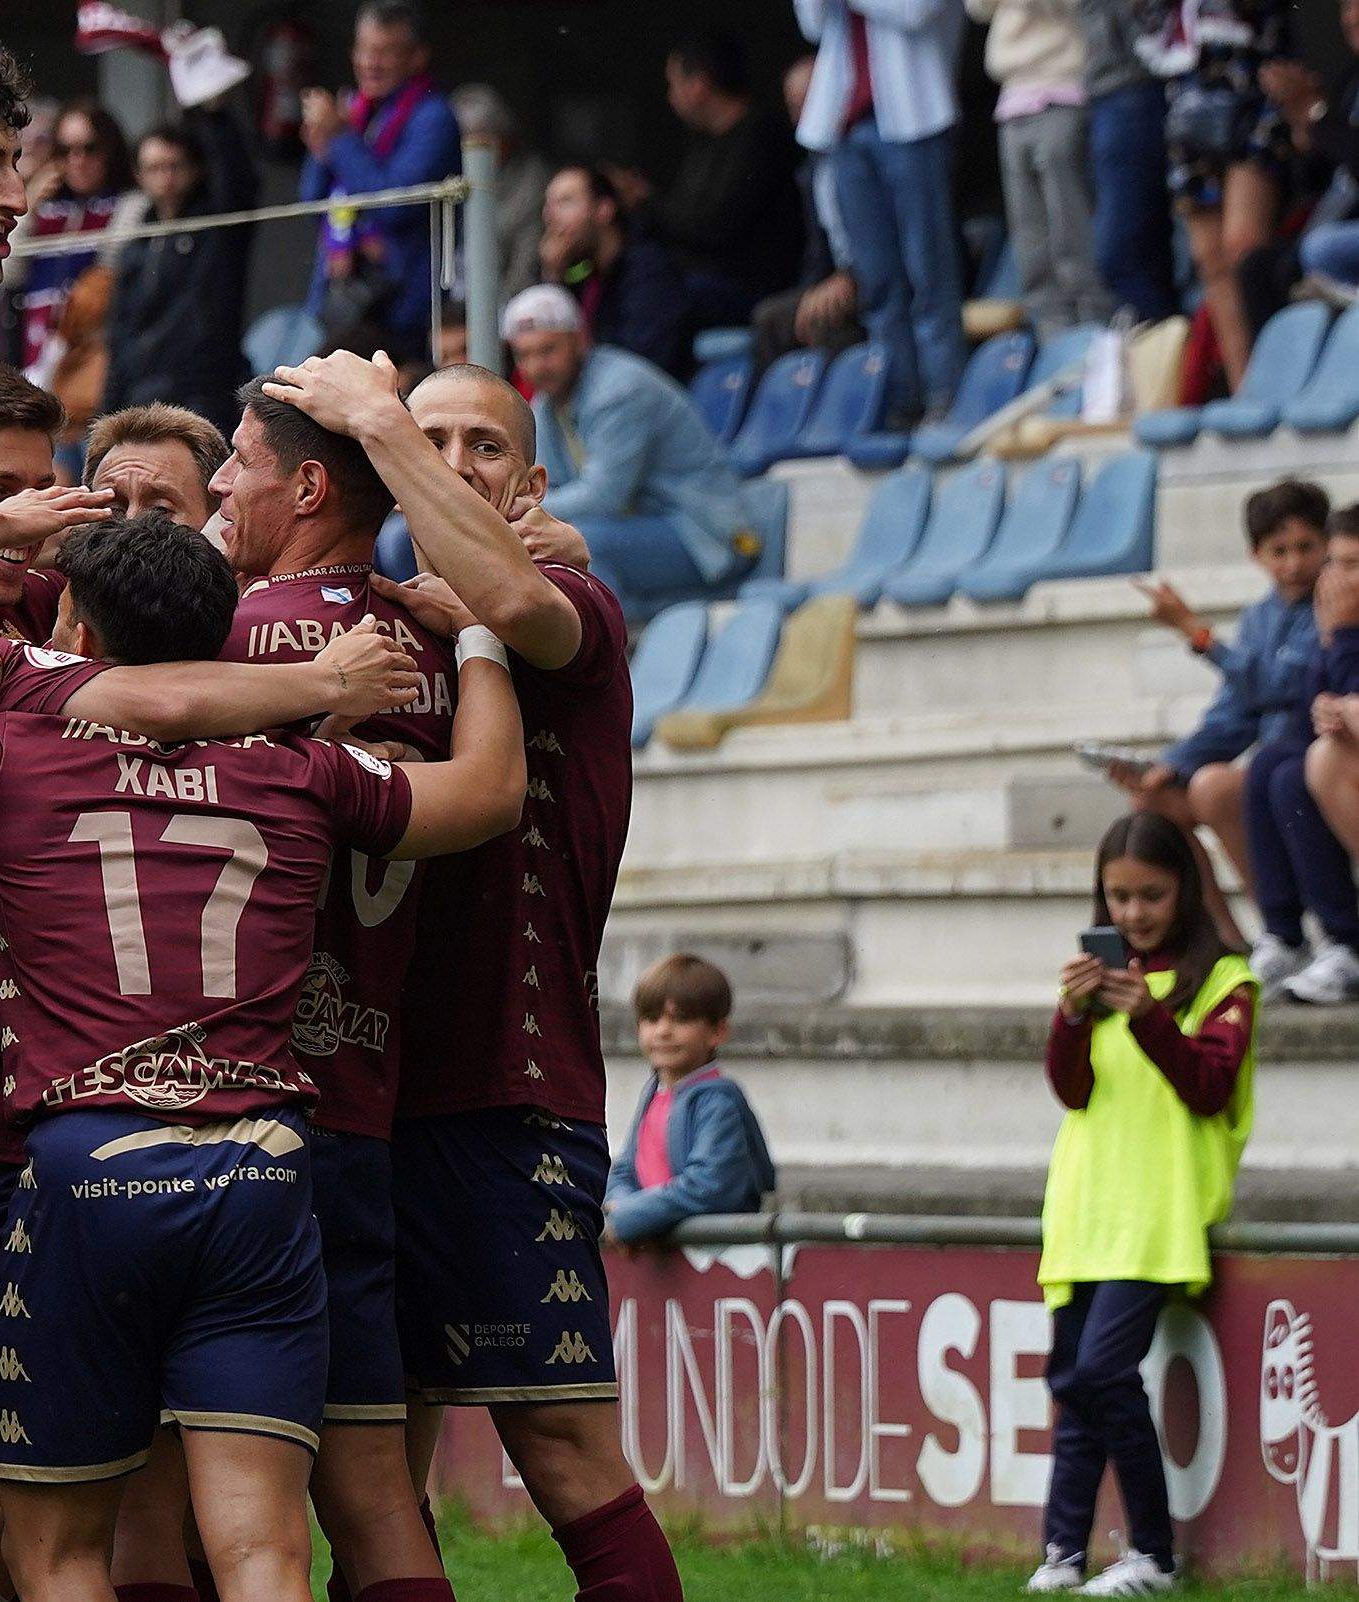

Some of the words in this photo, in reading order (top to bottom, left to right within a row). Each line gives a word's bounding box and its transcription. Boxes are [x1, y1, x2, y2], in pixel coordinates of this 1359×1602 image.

[271, 573, 295, 583] NON
[296, 566, 328, 579] PARAR
[328, 564, 347, 574] ATA
[114, 752, 219, 804] XABI
[68, 811, 269, 999] 17
[474, 1323, 531, 1335] DEPORTE
[474, 1336, 525, 1348] GALEGO
